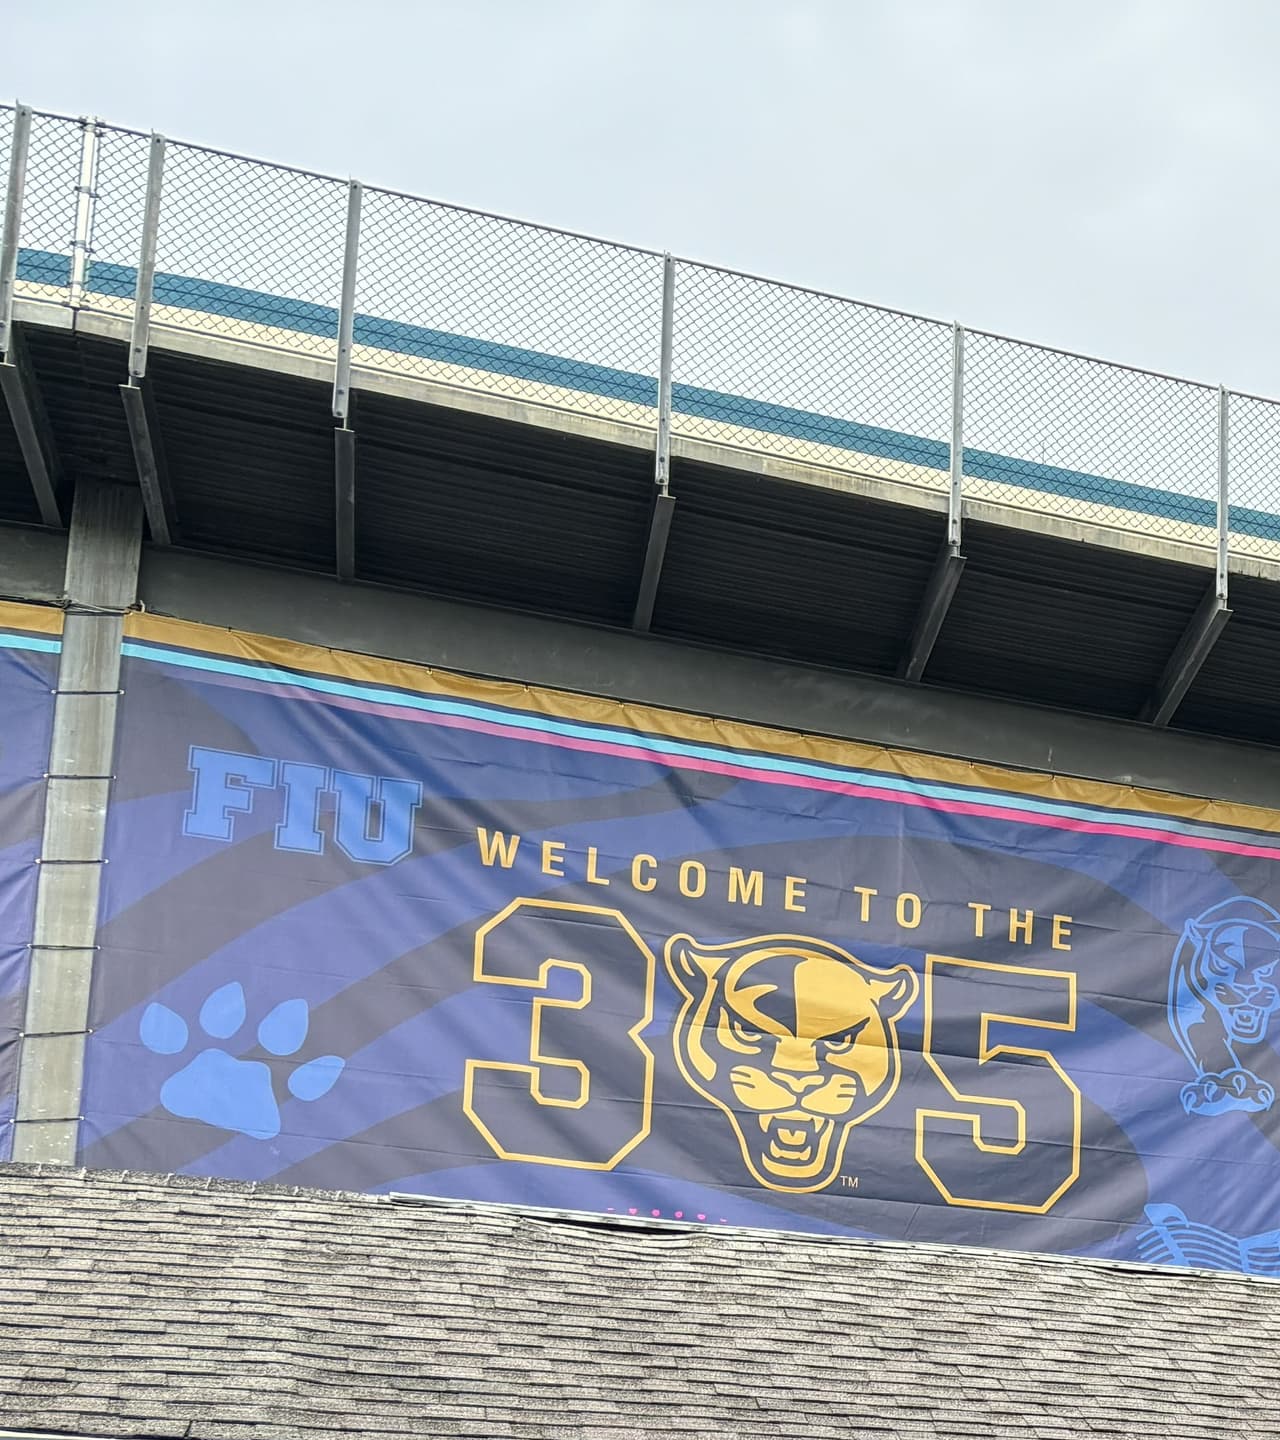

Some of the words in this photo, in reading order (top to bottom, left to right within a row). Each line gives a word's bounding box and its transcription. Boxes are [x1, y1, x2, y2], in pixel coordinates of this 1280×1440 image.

[183, 745, 424, 866] FIU
[476, 826, 808, 912] WELCOME
[853, 885, 922, 929] TO
[967, 901, 1075, 951] THE
